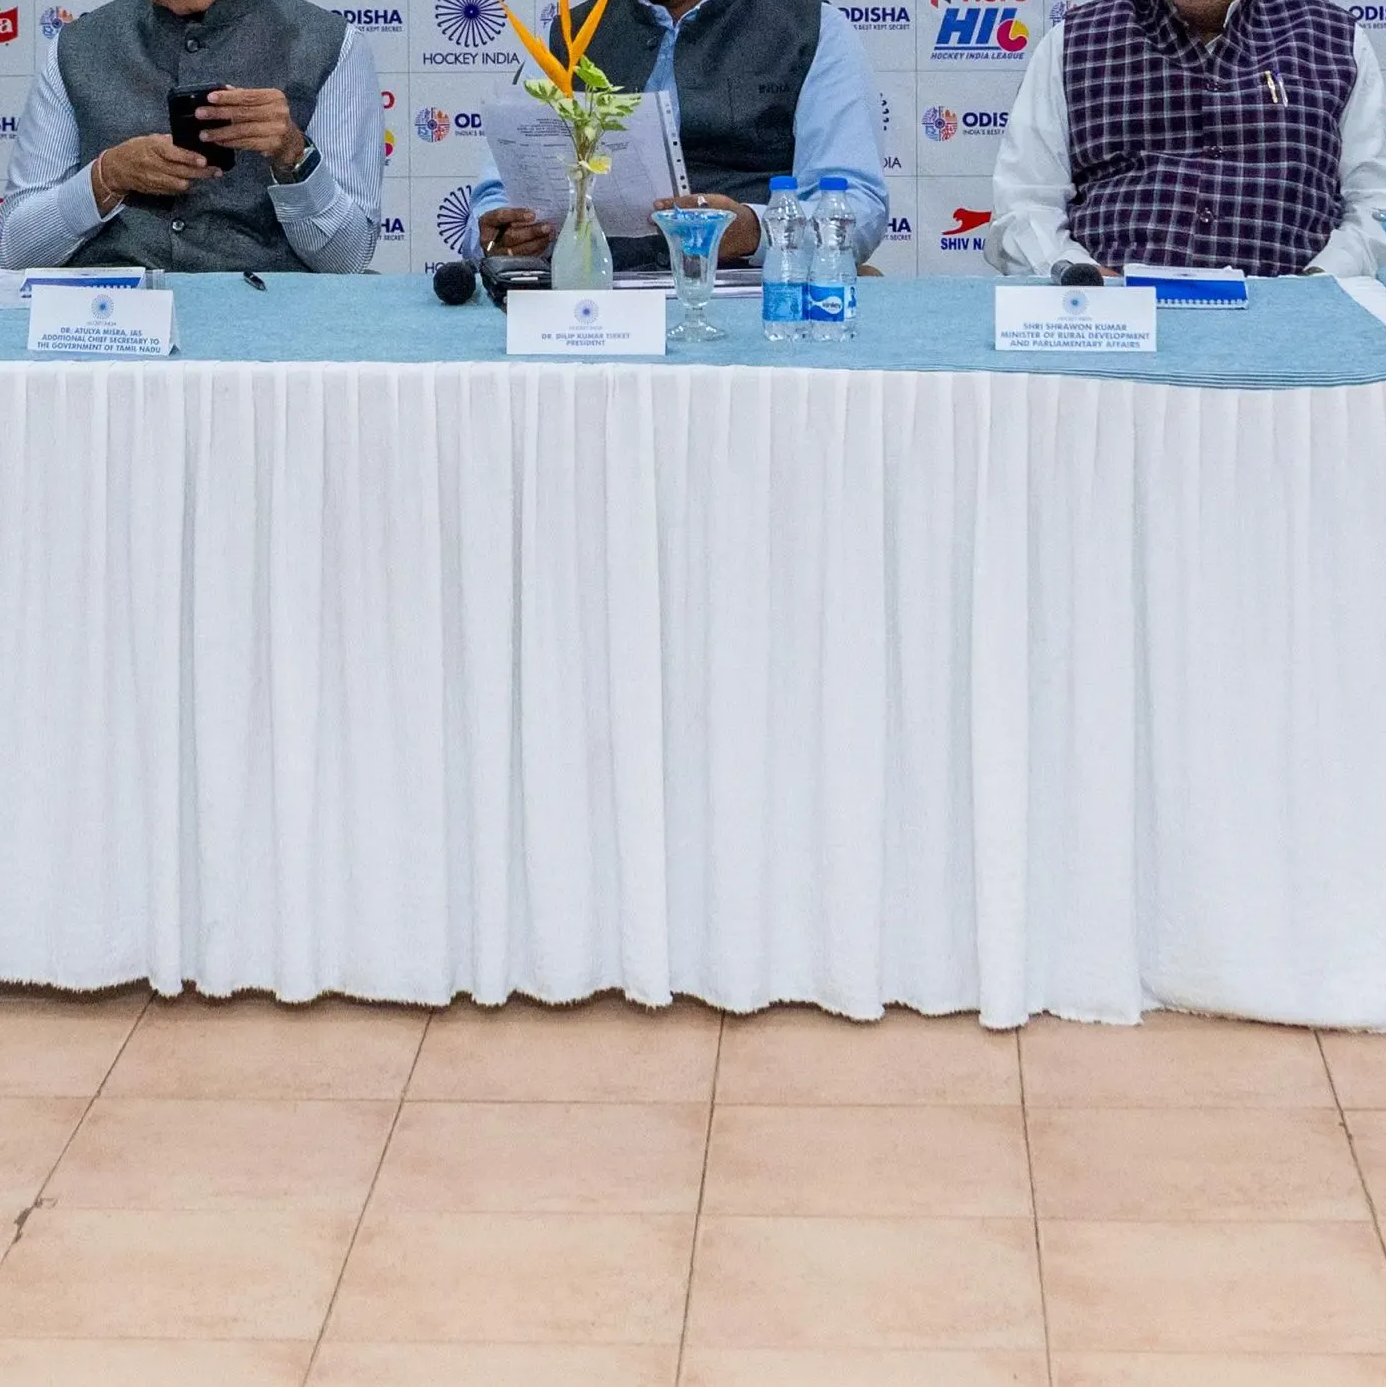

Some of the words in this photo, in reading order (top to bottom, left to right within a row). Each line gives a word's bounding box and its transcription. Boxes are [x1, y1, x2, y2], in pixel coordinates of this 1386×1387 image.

[423, 53, 478, 64] HOCKEY
[482, 52, 519, 64] INDIA
[963, 112, 1008, 127] ODIS
[941, 238, 969, 250] SHIV
[1088, 332, 1149, 340] DEVELOPMENT
